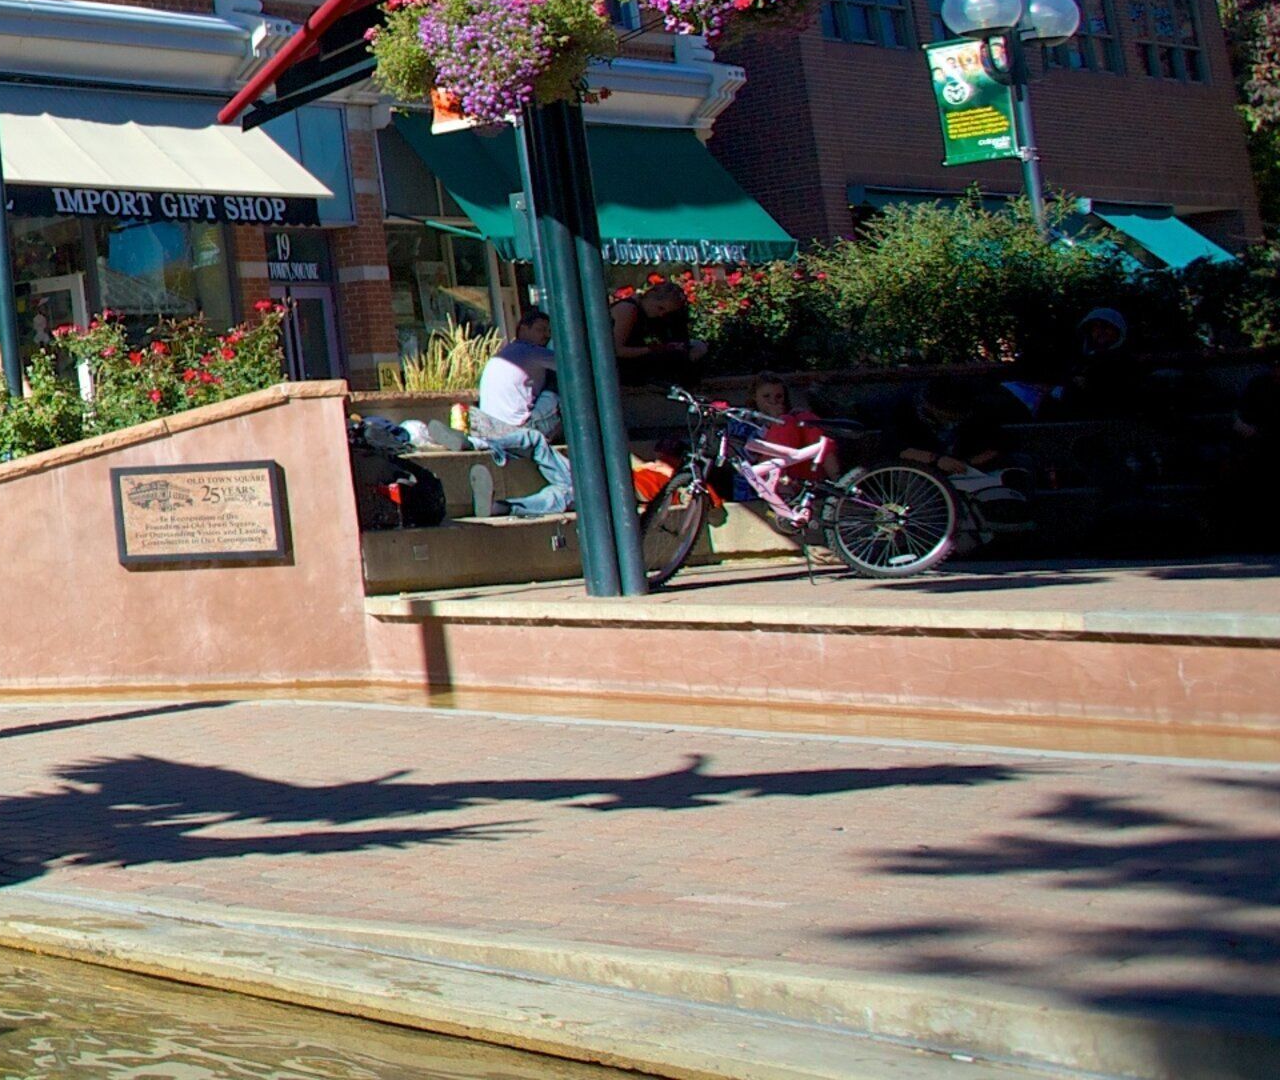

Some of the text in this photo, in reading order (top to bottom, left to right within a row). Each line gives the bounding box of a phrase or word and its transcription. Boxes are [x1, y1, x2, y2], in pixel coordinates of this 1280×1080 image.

[52, 187, 154, 217] IMPORT
[160, 193, 217, 219] GIFT
[223, 196, 286, 221] SHOP
[276, 233, 290, 260] 19
[201, 485, 221, 504] 25
